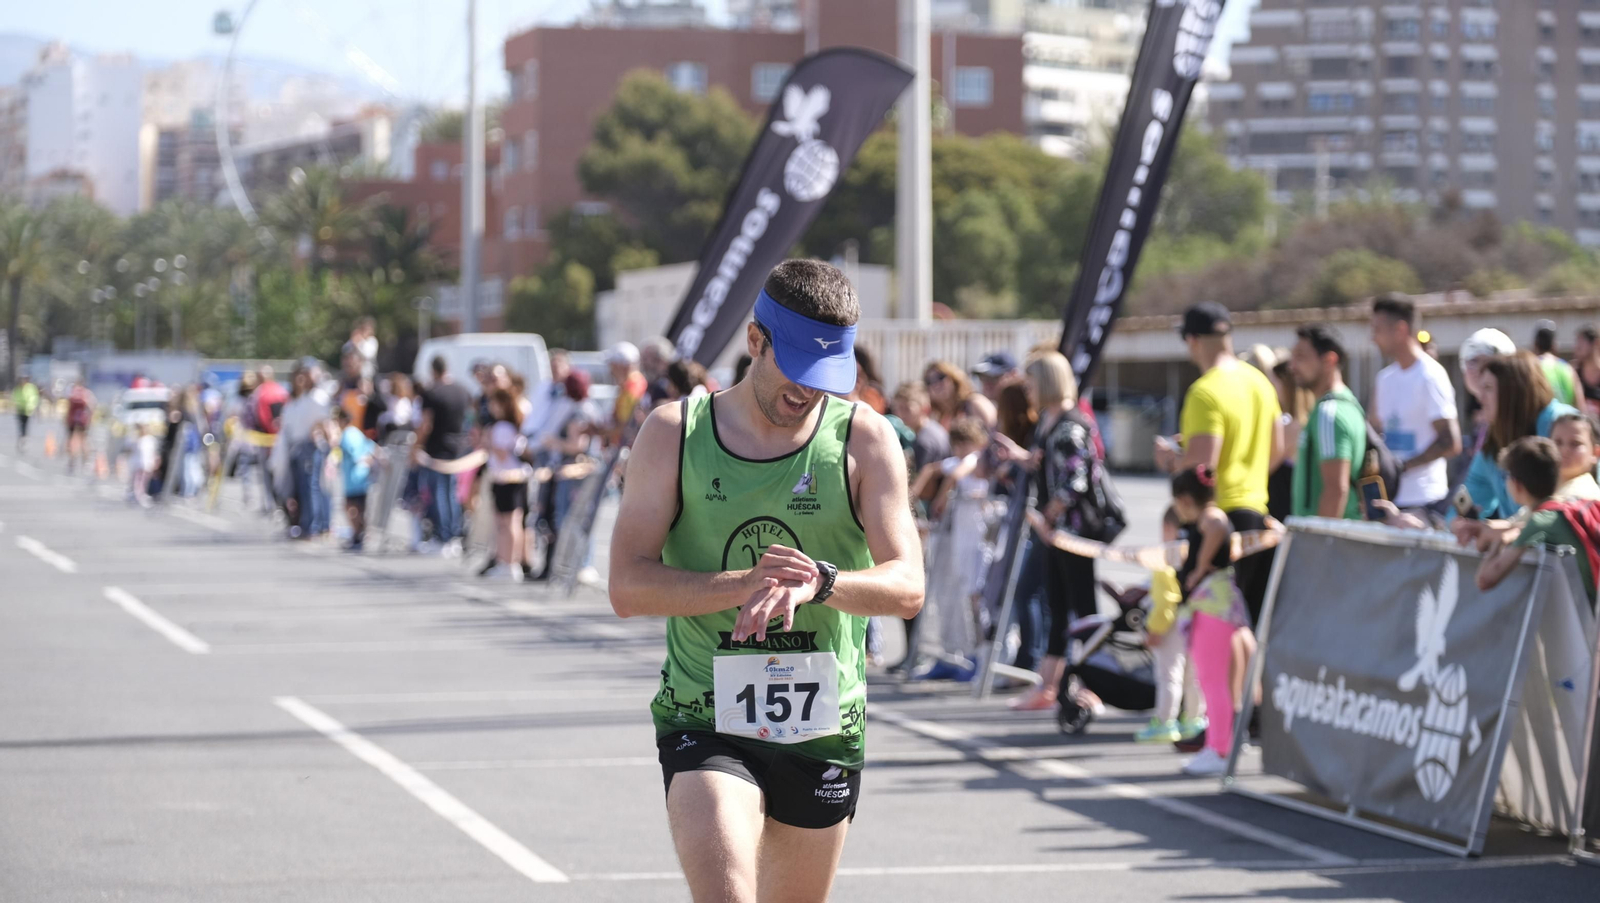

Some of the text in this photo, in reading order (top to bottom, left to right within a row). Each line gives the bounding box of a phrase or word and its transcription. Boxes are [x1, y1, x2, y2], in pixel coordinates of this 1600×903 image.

[786, 502, 822, 511] HUÉSCAR
[741, 523, 784, 540] HOTEL
[761, 634, 802, 649] MAÑO
[736, 682, 820, 723] 157
[1272, 666, 1424, 748] aquéatacamos
[814, 788, 850, 799] HUÉSCAR
